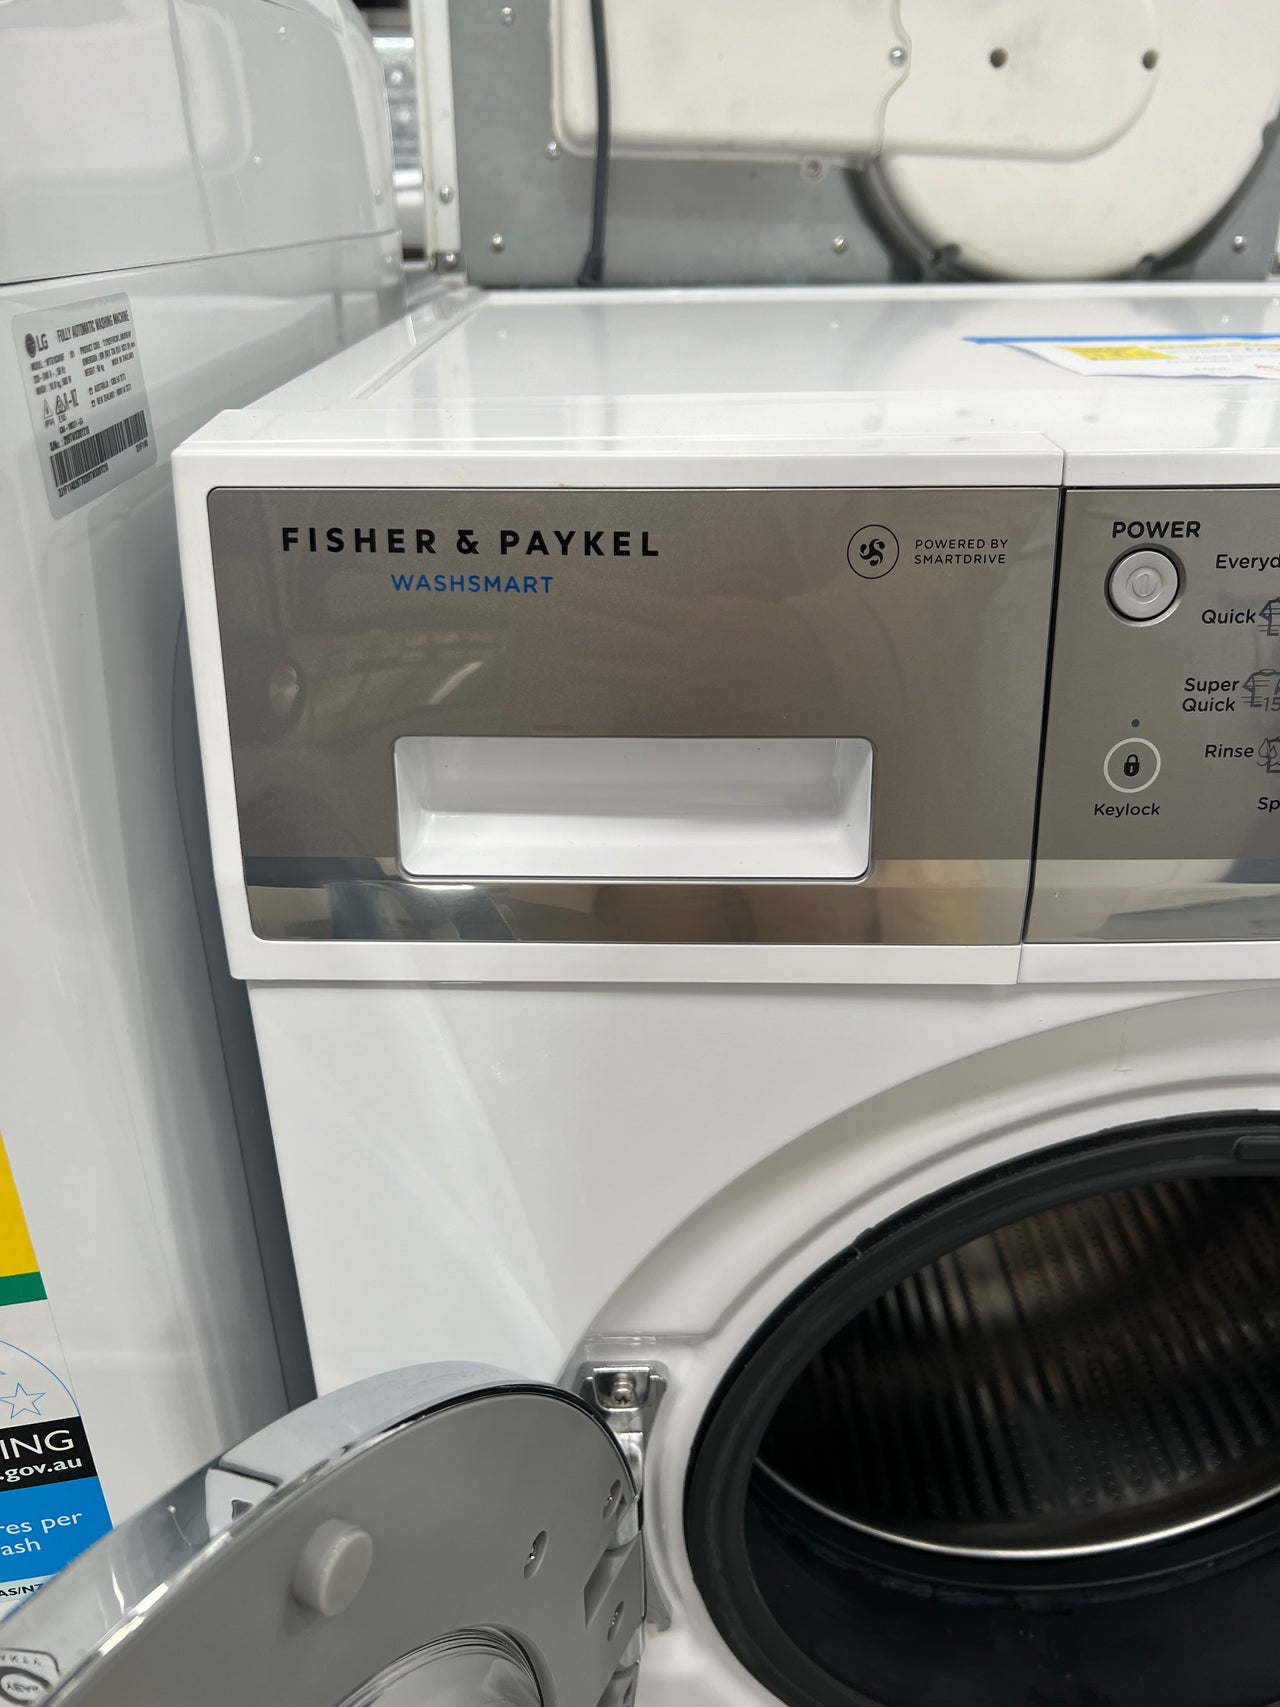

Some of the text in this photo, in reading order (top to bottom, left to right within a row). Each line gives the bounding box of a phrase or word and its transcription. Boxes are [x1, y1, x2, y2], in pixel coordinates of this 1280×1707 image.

[57, 310, 129, 342] FULLY AUTOMATIC WASHING MACHINE
[36, 333, 48, 351] LG
[1112, 521, 1201, 538] POWER
[282, 527, 659, 556] FISHER & PAYKEL
[915, 539, 1009, 549] POWERED BY
[914, 554, 1006, 565] SMARTDRIVE
[1216, 553, 1280, 571] Everyd
[391, 573, 554, 594] WASHSMART
[1201, 609, 1257, 624] Quick
[1184, 677, 1239, 694] Super
[1182, 697, 1236, 712] Quick
[1204, 744, 1254, 758] Rinse
[1094, 803, 1161, 818] Keylock
[41, 1511, 83, 1534] per
[0, 1537, 41, 1556] ash
